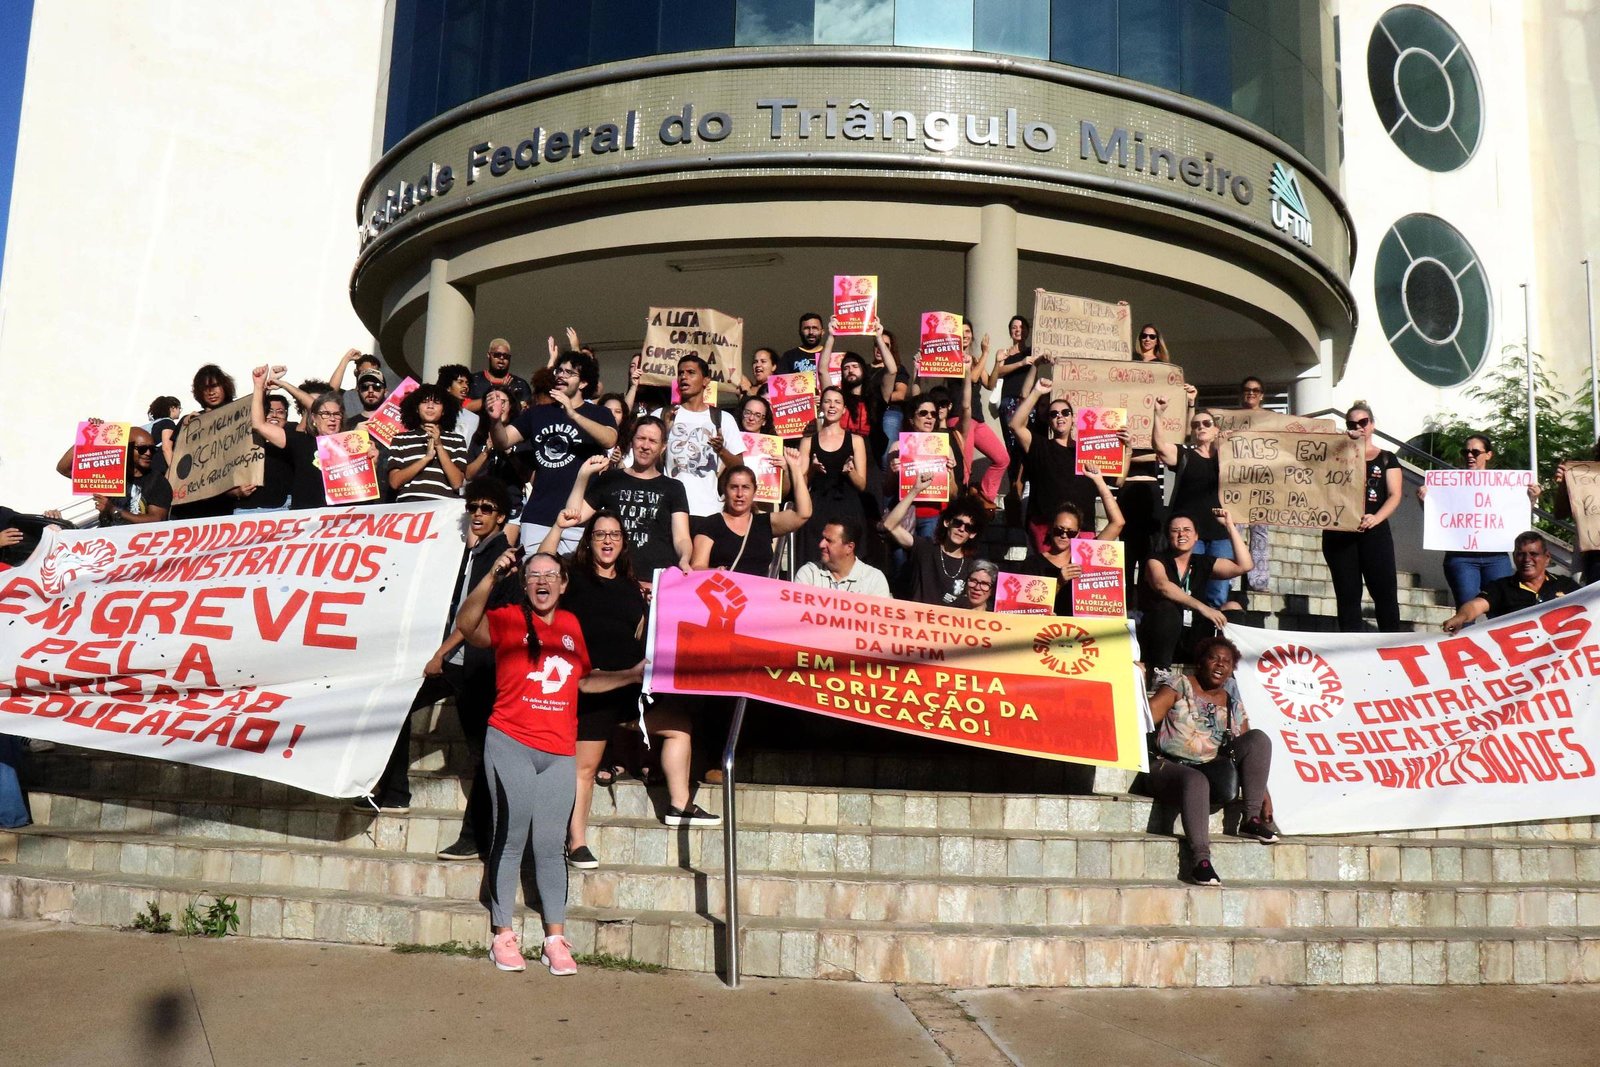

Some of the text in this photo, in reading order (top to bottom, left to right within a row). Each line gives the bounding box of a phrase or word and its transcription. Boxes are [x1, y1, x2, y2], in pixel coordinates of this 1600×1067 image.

[467, 109, 639, 186] Federal
[659, 103, 733, 146] do
[756, 98, 1058, 156] Triângulo
[1080, 120, 1254, 206] Mineiro
[1270, 199, 1313, 249] UFTM
[652, 310, 700, 328] A LUTA
[850, 304, 869, 313] GREV
[1039, 315, 1120, 337] UNIVERSIDADE
[708, 351, 717, 365] A
[936, 344, 960, 353] GREVE
[1060, 360, 1097, 383] TAES
[1109, 366, 1155, 384] CONTRA
[382, 408, 393, 418] EM
[775, 403, 811, 418] EM GREVE
[1081, 441, 1120, 452] EM GREVE
[1228, 436, 1328, 462] TAES EM
[79, 457, 121, 470] EM GREVE
[328, 464, 370, 481] EM GREVE
[905, 469, 917, 477] EM
[1228, 465, 1354, 487] LUTA POR 10%
[619, 489, 660, 504] NEW
[1224, 489, 1309, 508] DO PIB DA
[1474, 492, 1492, 508] DA
[1249, 506, 1346, 529] EDUCAÇÃO!
[1440, 512, 1505, 529] CARREIRA
[119, 517, 312, 561] SERVIDORES
[1463, 530, 1479, 550] JÁ
[91, 543, 388, 585] ADMINISTRATIVOS
[1077, 580, 1120, 591] EM GREVE
[780, 588, 1012, 634] SERVIDORES TÉCNICO-
[1075, 598, 1123, 606] VALORIZAÇÃO
[1086, 605, 1125, 614] EDUCAÇÃO!
[0, 576, 366, 651] EM GREVE
[800, 610, 994, 650] ADMINISTRATIVOS
[855, 637, 947, 662] DA UFTM
[1376, 604, 1593, 688] TAES
[20, 638, 221, 688] PELA
[797, 651, 1008, 697] EM LUTA PELA
[763, 666, 1040, 722] VALORIZAÇÃO DA
[1353, 682, 1488, 726] CONTRA
[1482, 670, 1534, 703] OS
[817, 691, 995, 738] EDUCAÇÃO!
[1279, 728, 1306, 756] E
[1305, 731, 1336, 757] O
[1293, 726, 1597, 790] DAS UNIVERSIDADES
